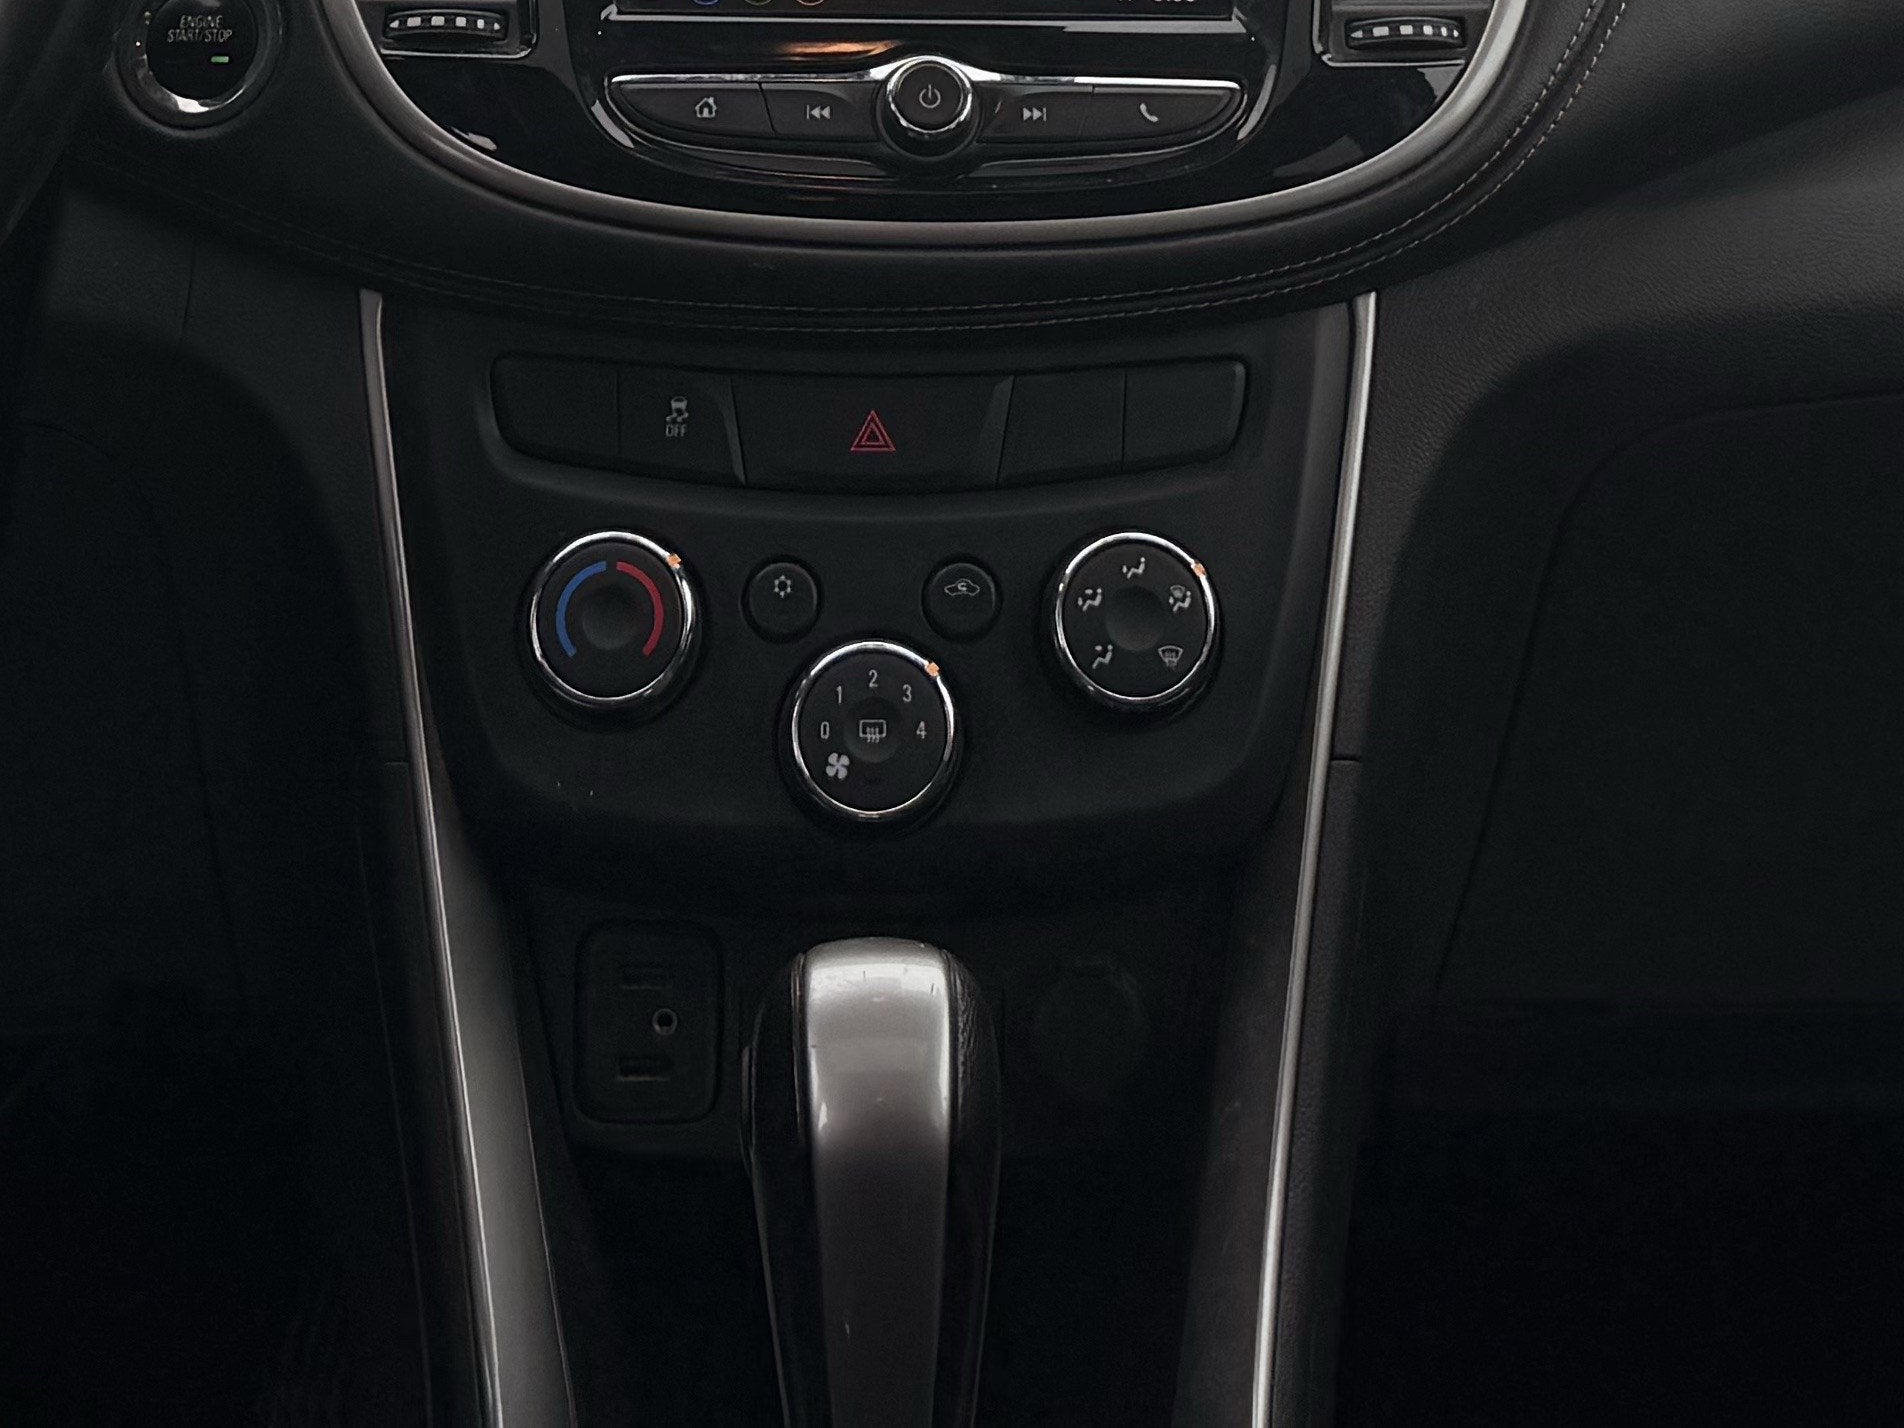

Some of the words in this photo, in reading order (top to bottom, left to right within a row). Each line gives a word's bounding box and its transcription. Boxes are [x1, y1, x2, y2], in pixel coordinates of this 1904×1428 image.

[179, 14, 224, 29] ENGINE
[166, 28, 233, 43] START/STOP
[665, 424, 688, 438] OFF
[819, 720, 830, 740] 0
[835, 686, 843, 705] 1
[868, 669, 879, 689] 2
[901, 683, 913, 704] 3
[916, 720, 928, 739] 4
